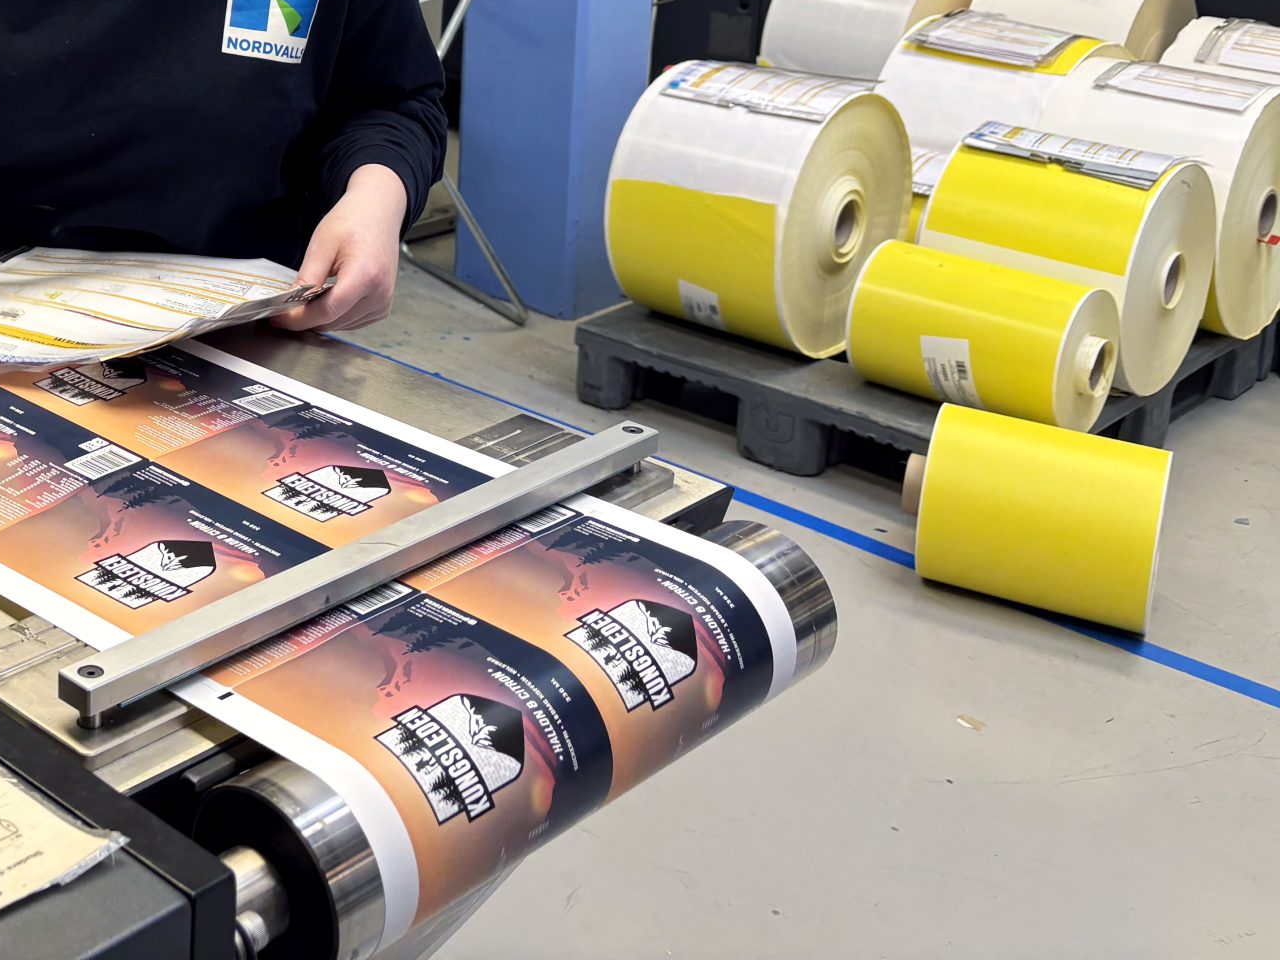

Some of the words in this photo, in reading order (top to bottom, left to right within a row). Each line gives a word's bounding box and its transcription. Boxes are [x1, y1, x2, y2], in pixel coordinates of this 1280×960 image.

[281, 473, 369, 514] KUNGSLEDEN
[190, 520, 217, 538] CITRON
[223, 535, 254, 554] HALLON
[98, 554, 188, 601] KUNGSLEDEN
[661, 580, 696, 605] CITRON
[704, 614, 730, 655] HALLON
[582, 609, 670, 708] KUNGSLEDEN
[491, 670, 528, 699] CITRON
[533, 711, 563, 754] HALLON
[397, 707, 490, 818] KUNGSLEDEN
